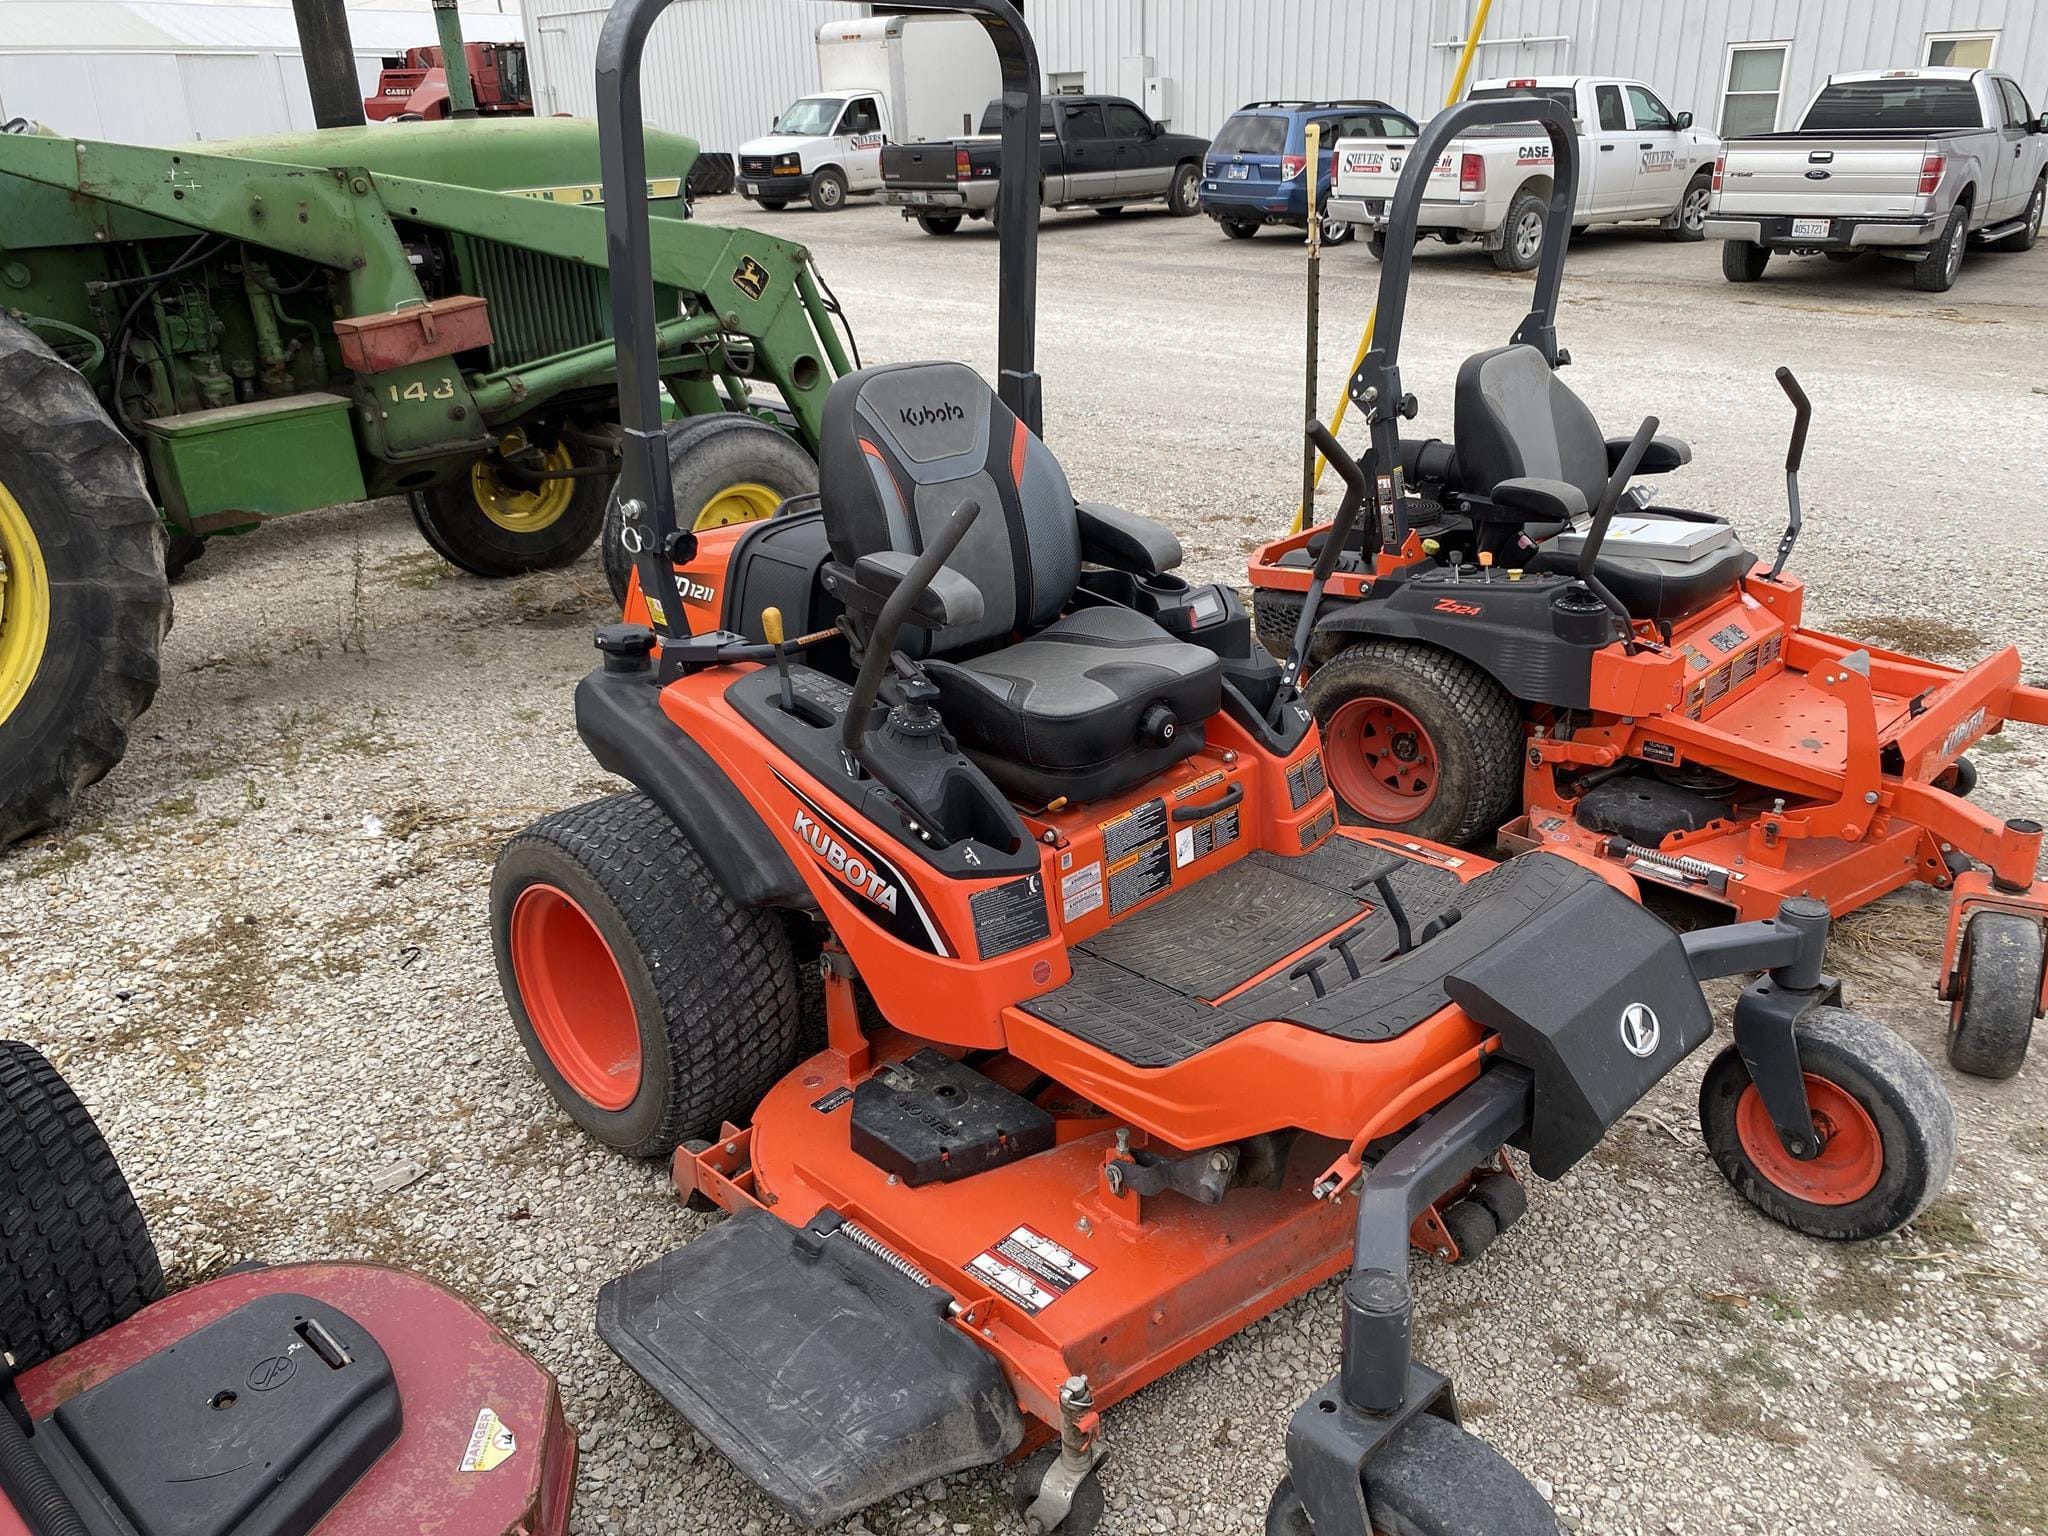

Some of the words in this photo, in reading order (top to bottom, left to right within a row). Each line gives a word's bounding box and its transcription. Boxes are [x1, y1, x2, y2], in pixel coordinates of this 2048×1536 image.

[385, 88, 406, 96] CASE
[1343, 153, 1385, 173] SIEVERS
[1518, 146, 1549, 158] CASE
[1639, 150, 1674, 175] SIEVERS
[390, 378, 454, 402] 143
[899, 402, 965, 427] Kubota
[793, 809, 898, 916] KUBOTA
[921, 1113, 959, 1137] STEP
[1011, 1266, 1037, 1285] DANGER
[464, 1413, 492, 1466] DANGER
